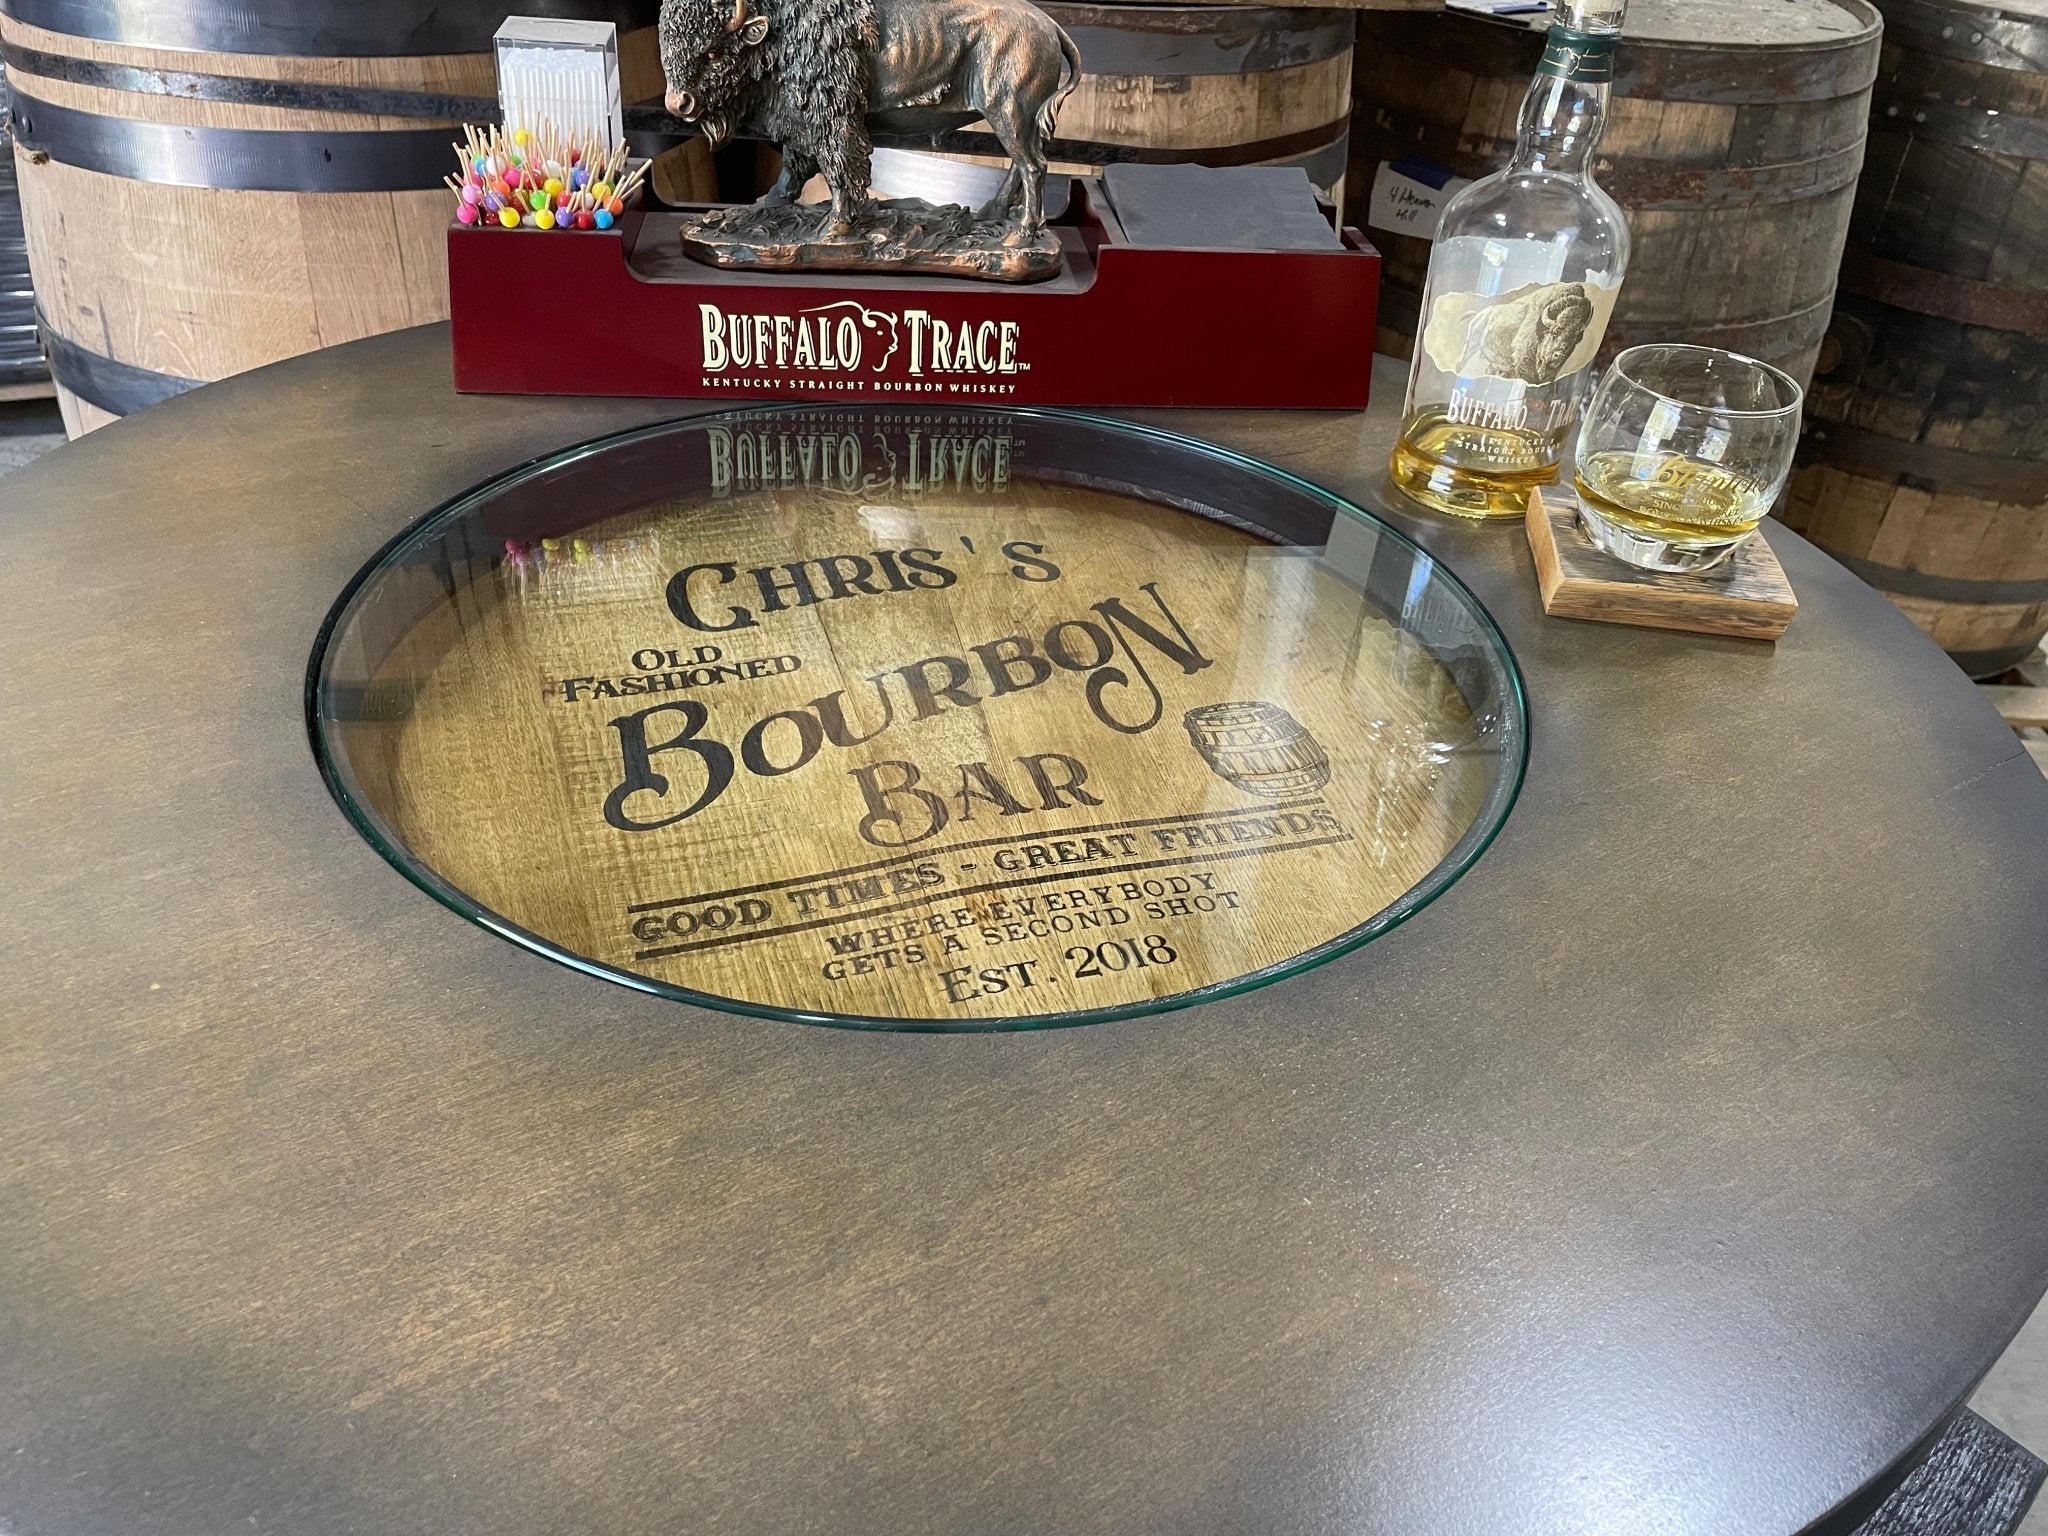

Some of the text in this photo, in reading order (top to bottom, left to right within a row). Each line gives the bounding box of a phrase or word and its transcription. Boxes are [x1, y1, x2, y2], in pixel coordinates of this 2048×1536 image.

[698, 304, 862, 372] BUFFALO
[904, 310, 1020, 377] TRACE
[702, 377, 1016, 393] KENTUCKY STRAIGHT BOURBON WHISKEY
[1446, 388, 1528, 431] BUFFALO
[560, 655, 802, 702] FASHIONED
[631, 645, 722, 671] OLD
[603, 581, 1213, 832] BOURBON
[847, 753, 1104, 848] BAR
[632, 897, 772, 943] GOOD
[786, 862, 945, 915] TIMES
[993, 832, 1138, 873] GREAT
[1150, 808, 1344, 852] FRIENDS
[822, 890, 1241, 981] GETS A SECOND SHOT
[826, 872, 1217, 956] WHERE EVERYBODY
[1065, 934, 1178, 979] 2018
